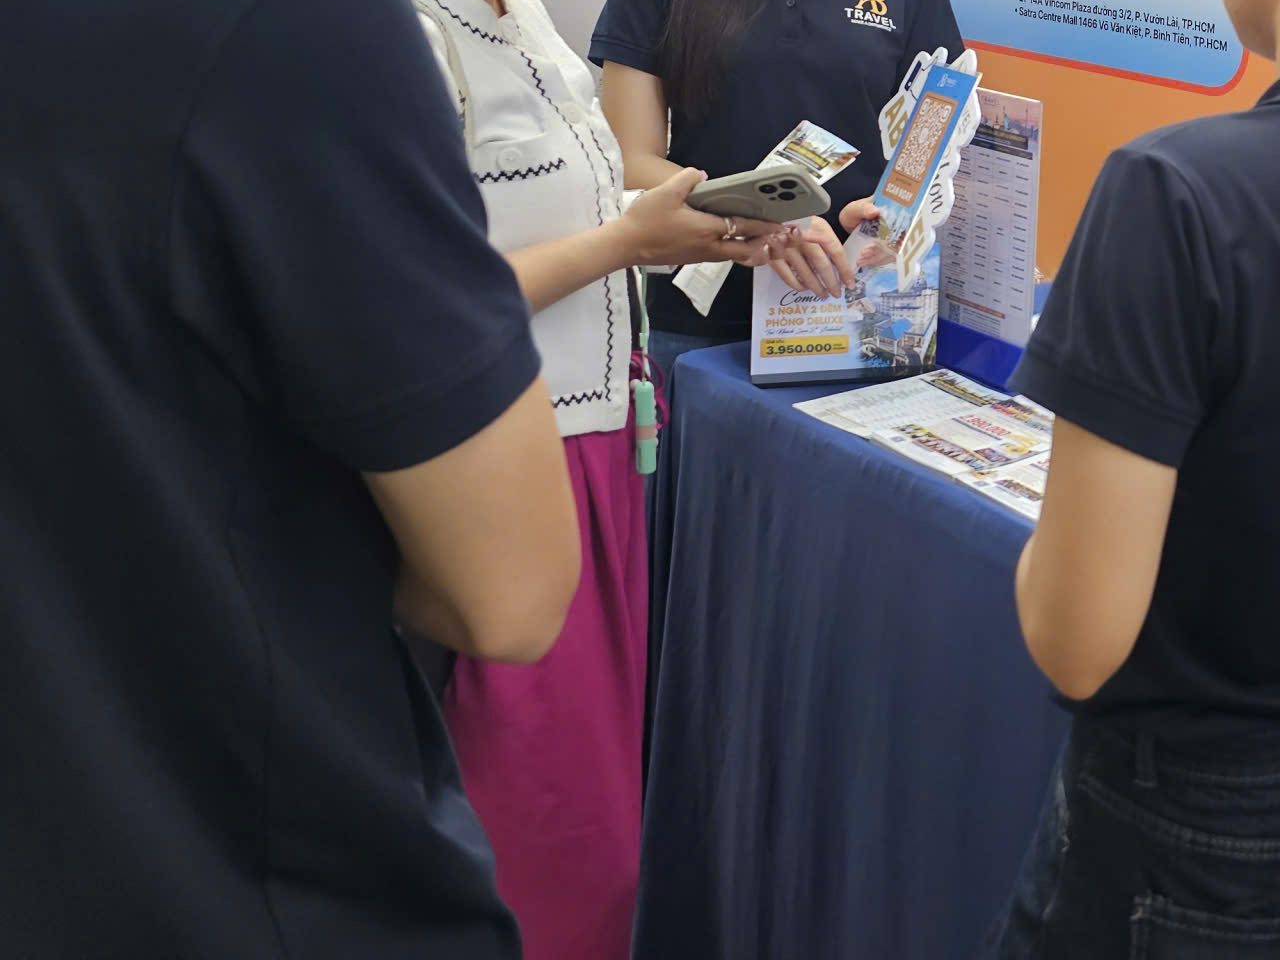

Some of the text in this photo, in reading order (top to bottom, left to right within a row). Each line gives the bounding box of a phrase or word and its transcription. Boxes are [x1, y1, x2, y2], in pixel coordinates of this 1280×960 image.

[843, 7, 897, 30] TRAVEL
[1018, 6, 1037, 19] Satra
[1038, 9, 1062, 24] Centre
[1062, 14, 1078, 27] Mall
[1078, 16, 1098, 30] 1466
[1098, 19, 1109, 32] Võ
[1125, 23, 1144, 39] Kiệt,
[1193, 35, 1228, 52] TP.HCM
[1071, 0, 1092, 14] Plaza
[1092, 4, 1118, 21] đường
[1118, 8, 1134, 23] 3/2,
[1182, 18, 1216, 34] TP.HCM
[766, 343, 832, 356] 3.950.000
